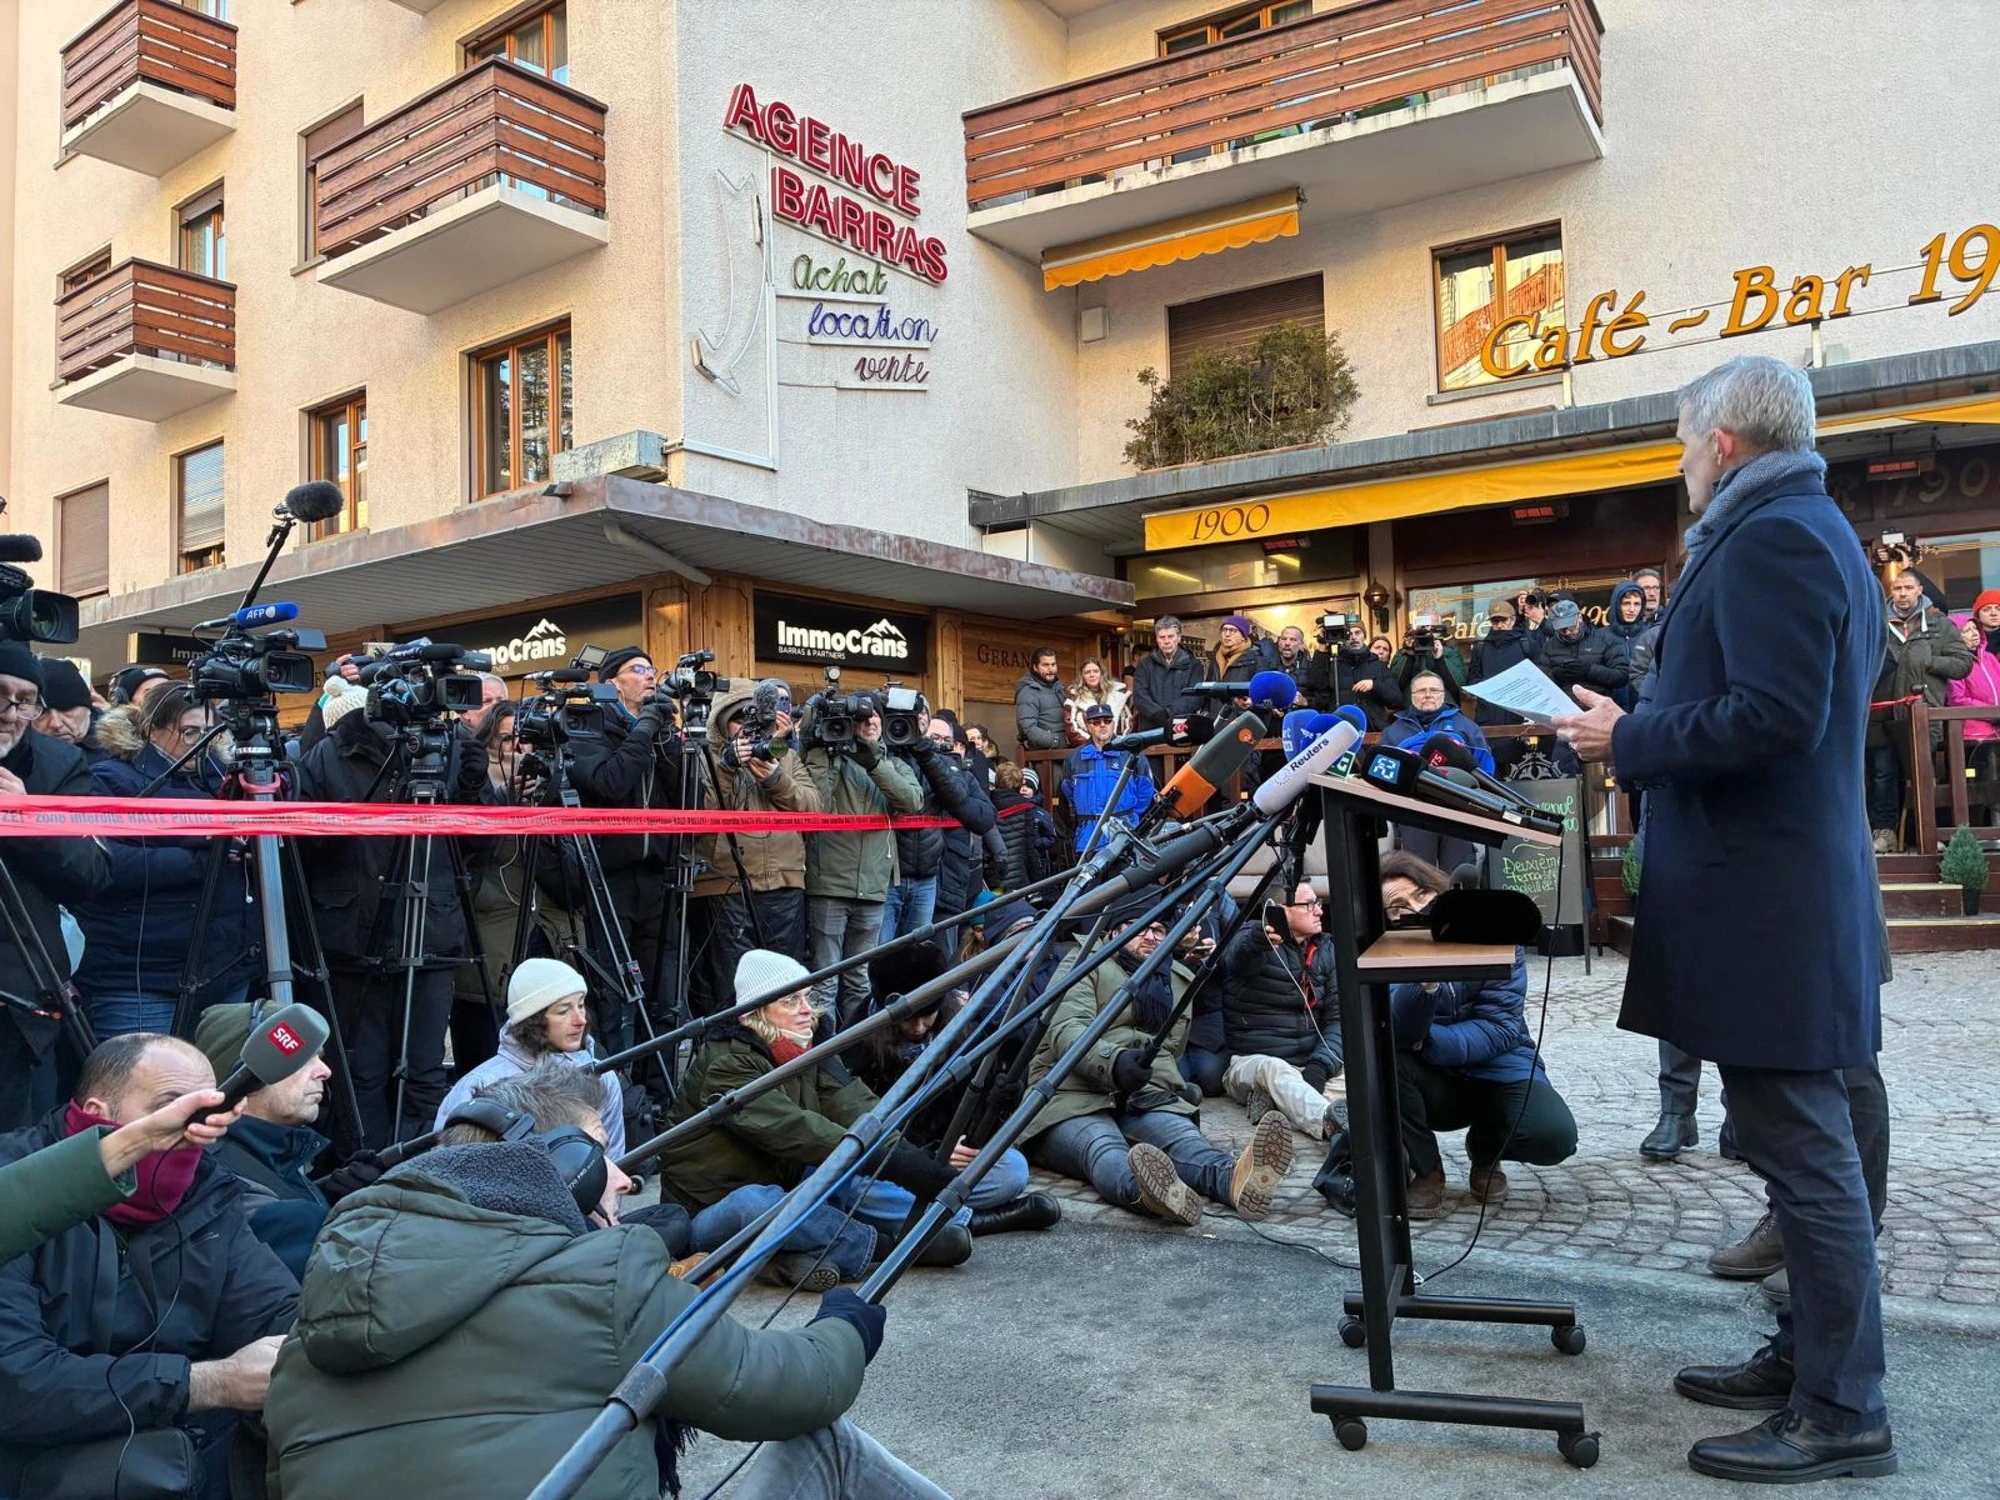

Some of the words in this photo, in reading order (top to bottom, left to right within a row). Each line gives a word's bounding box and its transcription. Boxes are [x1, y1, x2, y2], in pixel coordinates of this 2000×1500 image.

[725, 83, 921, 216] AGENCE
[771, 166, 948, 282] BARRAS
[792, 253, 889, 295] achat
[808, 302, 939, 342] location
[1480, 289, 1650, 379] Café
[1720, 263, 1872, 338] Bar
[854, 353, 930, 384] vente
[1189, 503, 1270, 541] 1900
[246, 607, 265, 620] AFP
[777, 619, 909, 659] ImmoCrans
[778, 646, 806, 656] BARRAS
[812, 649, 846, 660] PARTNERS
[977, 643, 1031, 670] GERAN
[1290, 738, 1330, 772] Reuters
[172, 811, 214, 824] POLICE
[272, 1027, 300, 1051] SRF
